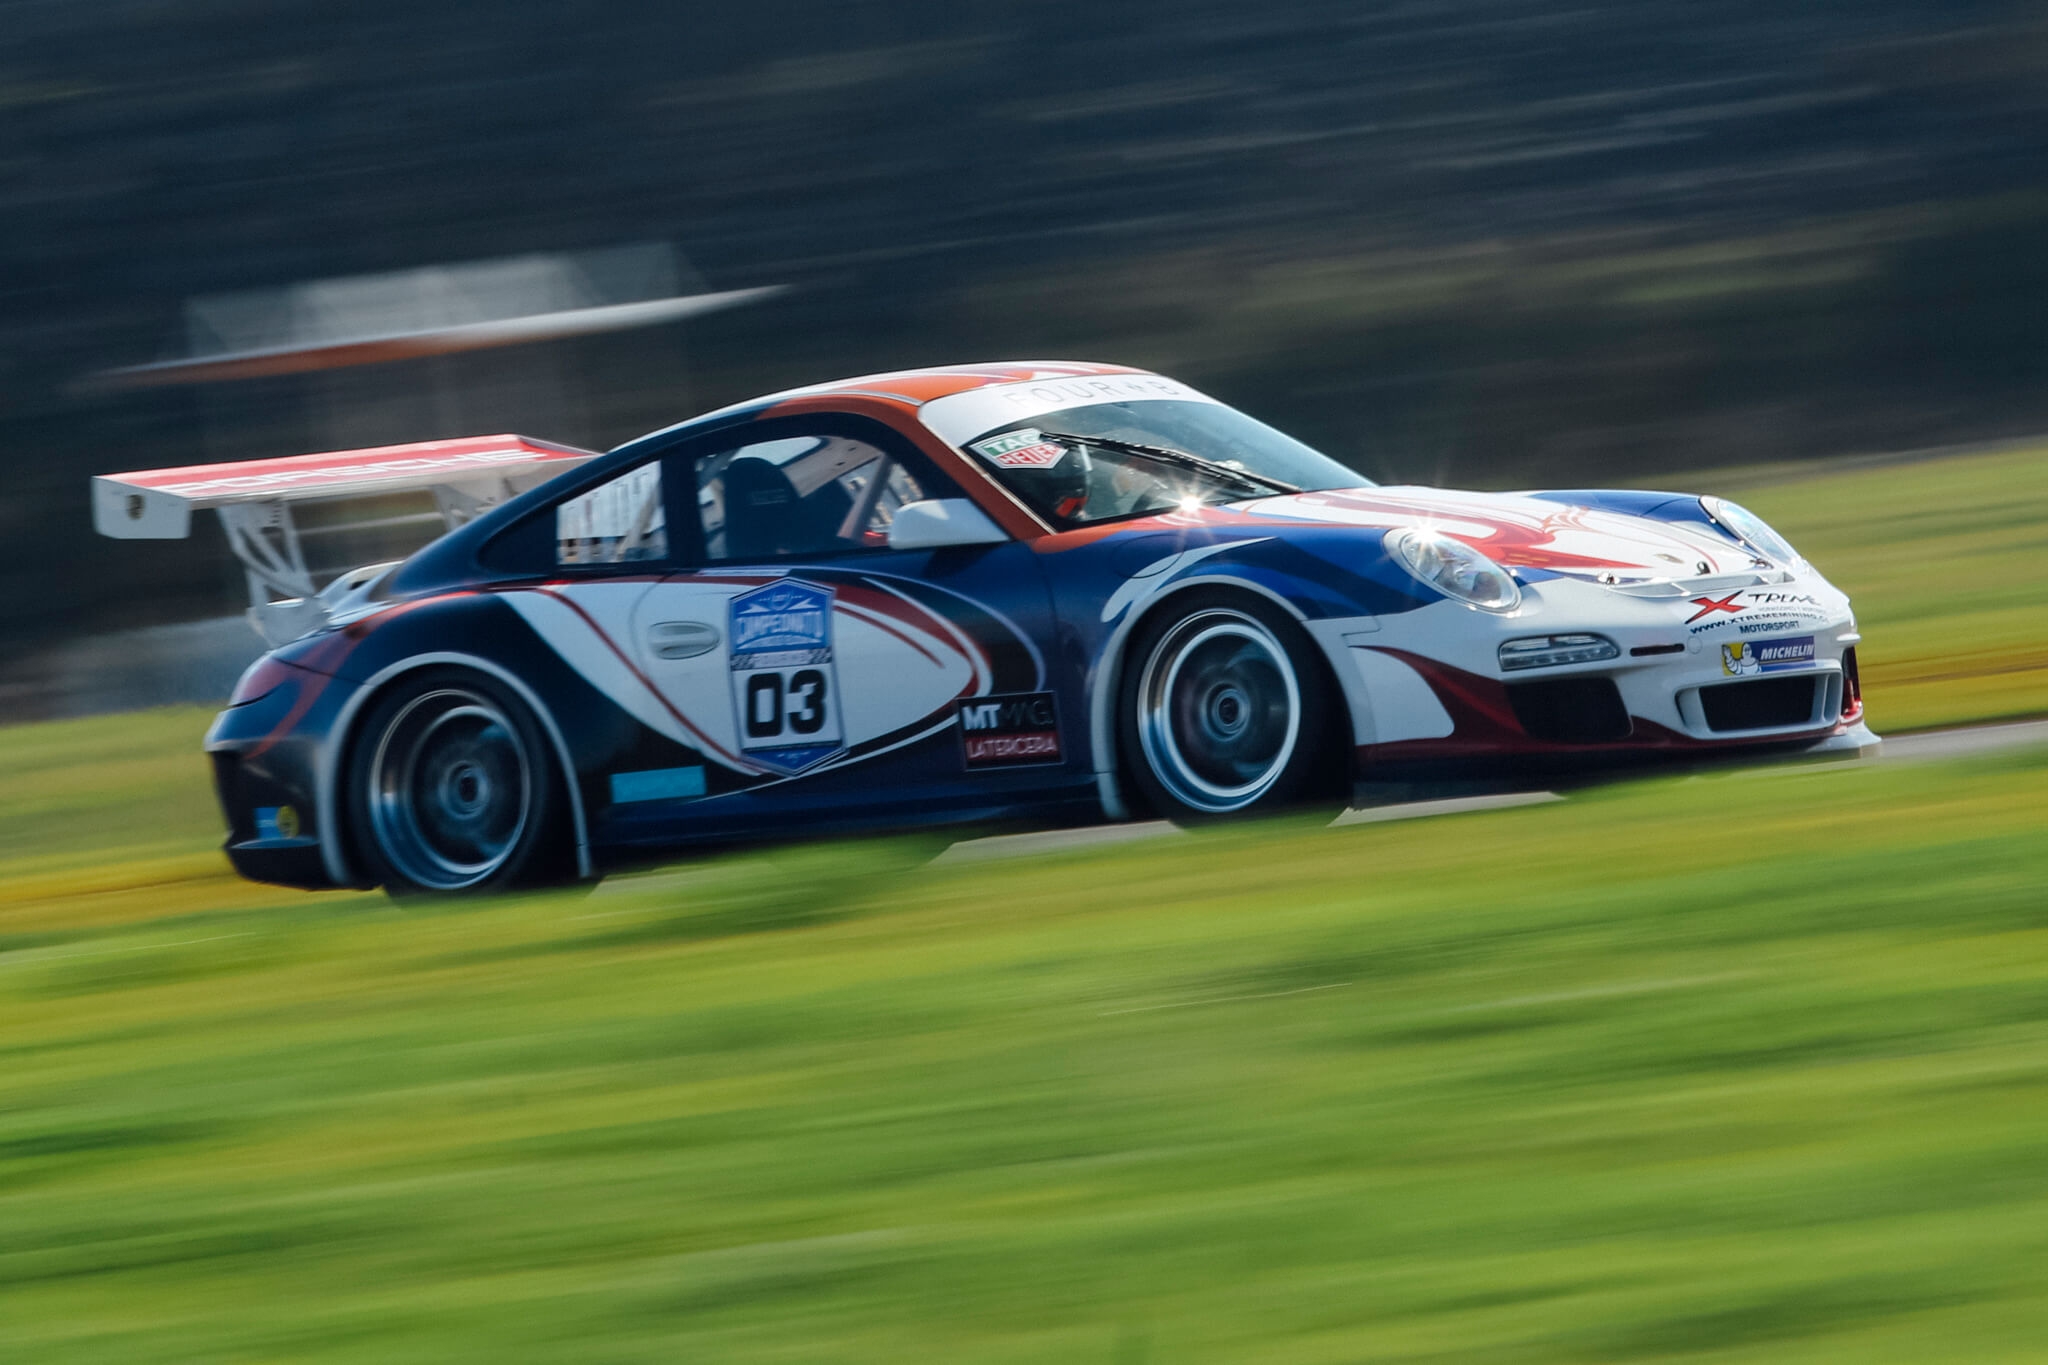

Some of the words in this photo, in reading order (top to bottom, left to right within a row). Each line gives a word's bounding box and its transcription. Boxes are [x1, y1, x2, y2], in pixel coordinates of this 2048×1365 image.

[998, 443, 1059, 464] HEUER
[150, 449, 547, 494] PORSCHE
[1739, 620, 1800, 634] MOTORSPORT
[1760, 644, 1815, 660] MICHELIN
[747, 669, 827, 738] 03
